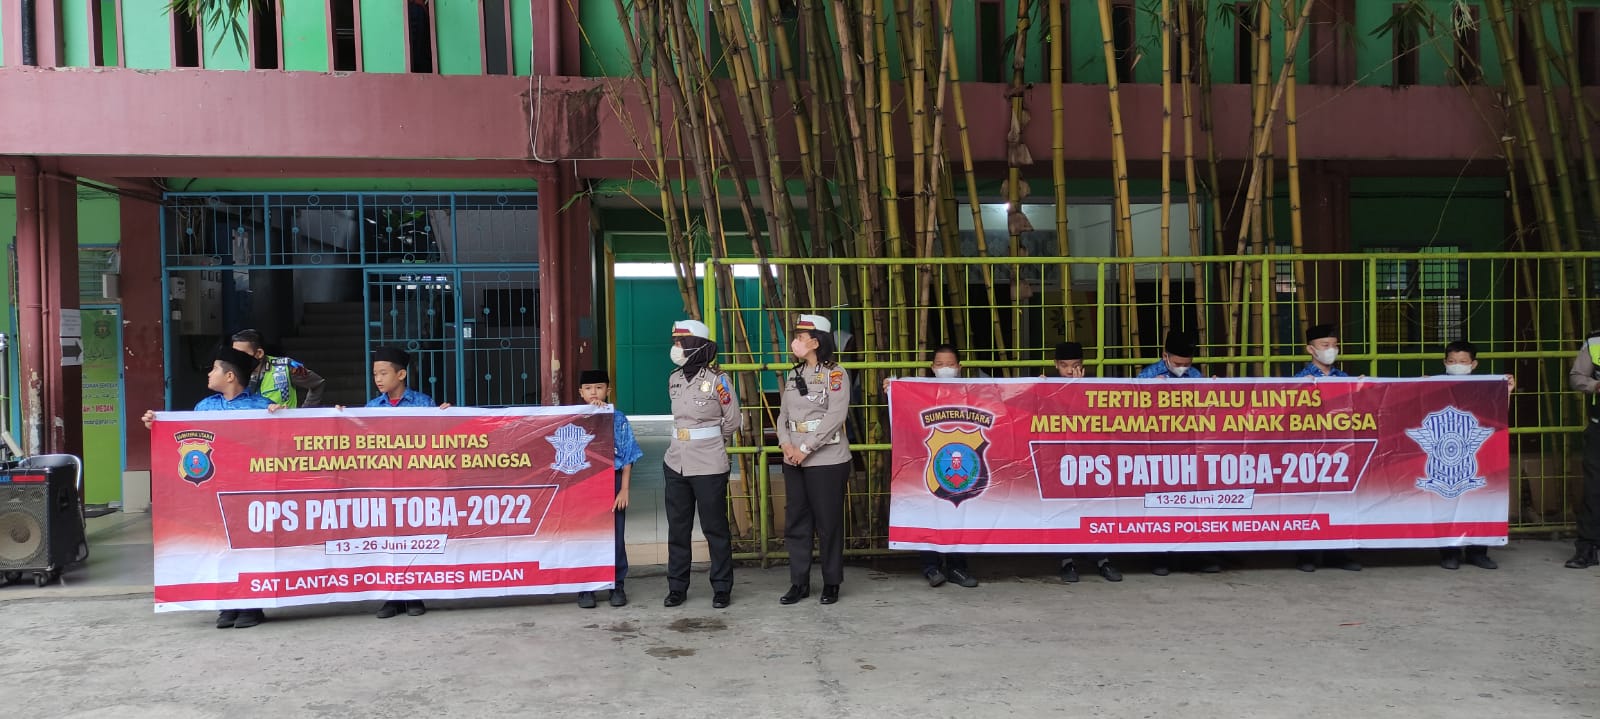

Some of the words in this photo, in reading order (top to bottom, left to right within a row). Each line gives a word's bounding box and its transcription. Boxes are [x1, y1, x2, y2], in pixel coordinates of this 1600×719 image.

[1085, 390, 1152, 408] TERTIB
[1158, 390, 1245, 408] BERLALU
[1251, 389, 1322, 408] LINTAS
[924, 410, 965, 424] SUMATERA
[966, 411, 990, 424] UTARA
[1030, 414, 1216, 433] MENYELAMATKAN
[1222, 414, 1285, 432] ANAK
[1289, 413, 1377, 431] BANGSA
[293, 435, 350, 451] TERTIB
[355, 434, 427, 450] BERLALU
[431, 434, 489, 449] LINTAS
[250, 454, 403, 473] MENYELAMATKAN
[407, 454, 457, 470] ANAK
[461, 453, 532, 469] BANGSA
[1060, 454, 1111, 486] OPS
[1118, 453, 1197, 486] PATUH
[1203, 451, 1349, 486] TOBA-2022
[1157, 495, 1187, 505] 13-26
[1189, 494, 1215, 505] Juni
[1217, 494, 1245, 504] 2022
[248, 500, 299, 533] OPS
[306, 497, 387, 531] PATUH
[392, 494, 532, 528] TOBA-2022
[1089, 522, 1115, 534] SAT
[1118, 521, 1171, 534] LANTAS
[1174, 520, 1229, 533] POLSEK
[1232, 520, 1280, 532] MEDAN
[1282, 519, 1320, 531] AREA
[335, 542, 350, 552] 13
[362, 540, 378, 551] 26
[381, 540, 406, 550] Juni
[410, 539, 440, 550] 2022
[250, 578, 281, 592] SAT
[285, 574, 349, 591] LANTAS
[353, 570, 465, 586] POLRESTABES
[469, 568, 524, 582] MEDAN
